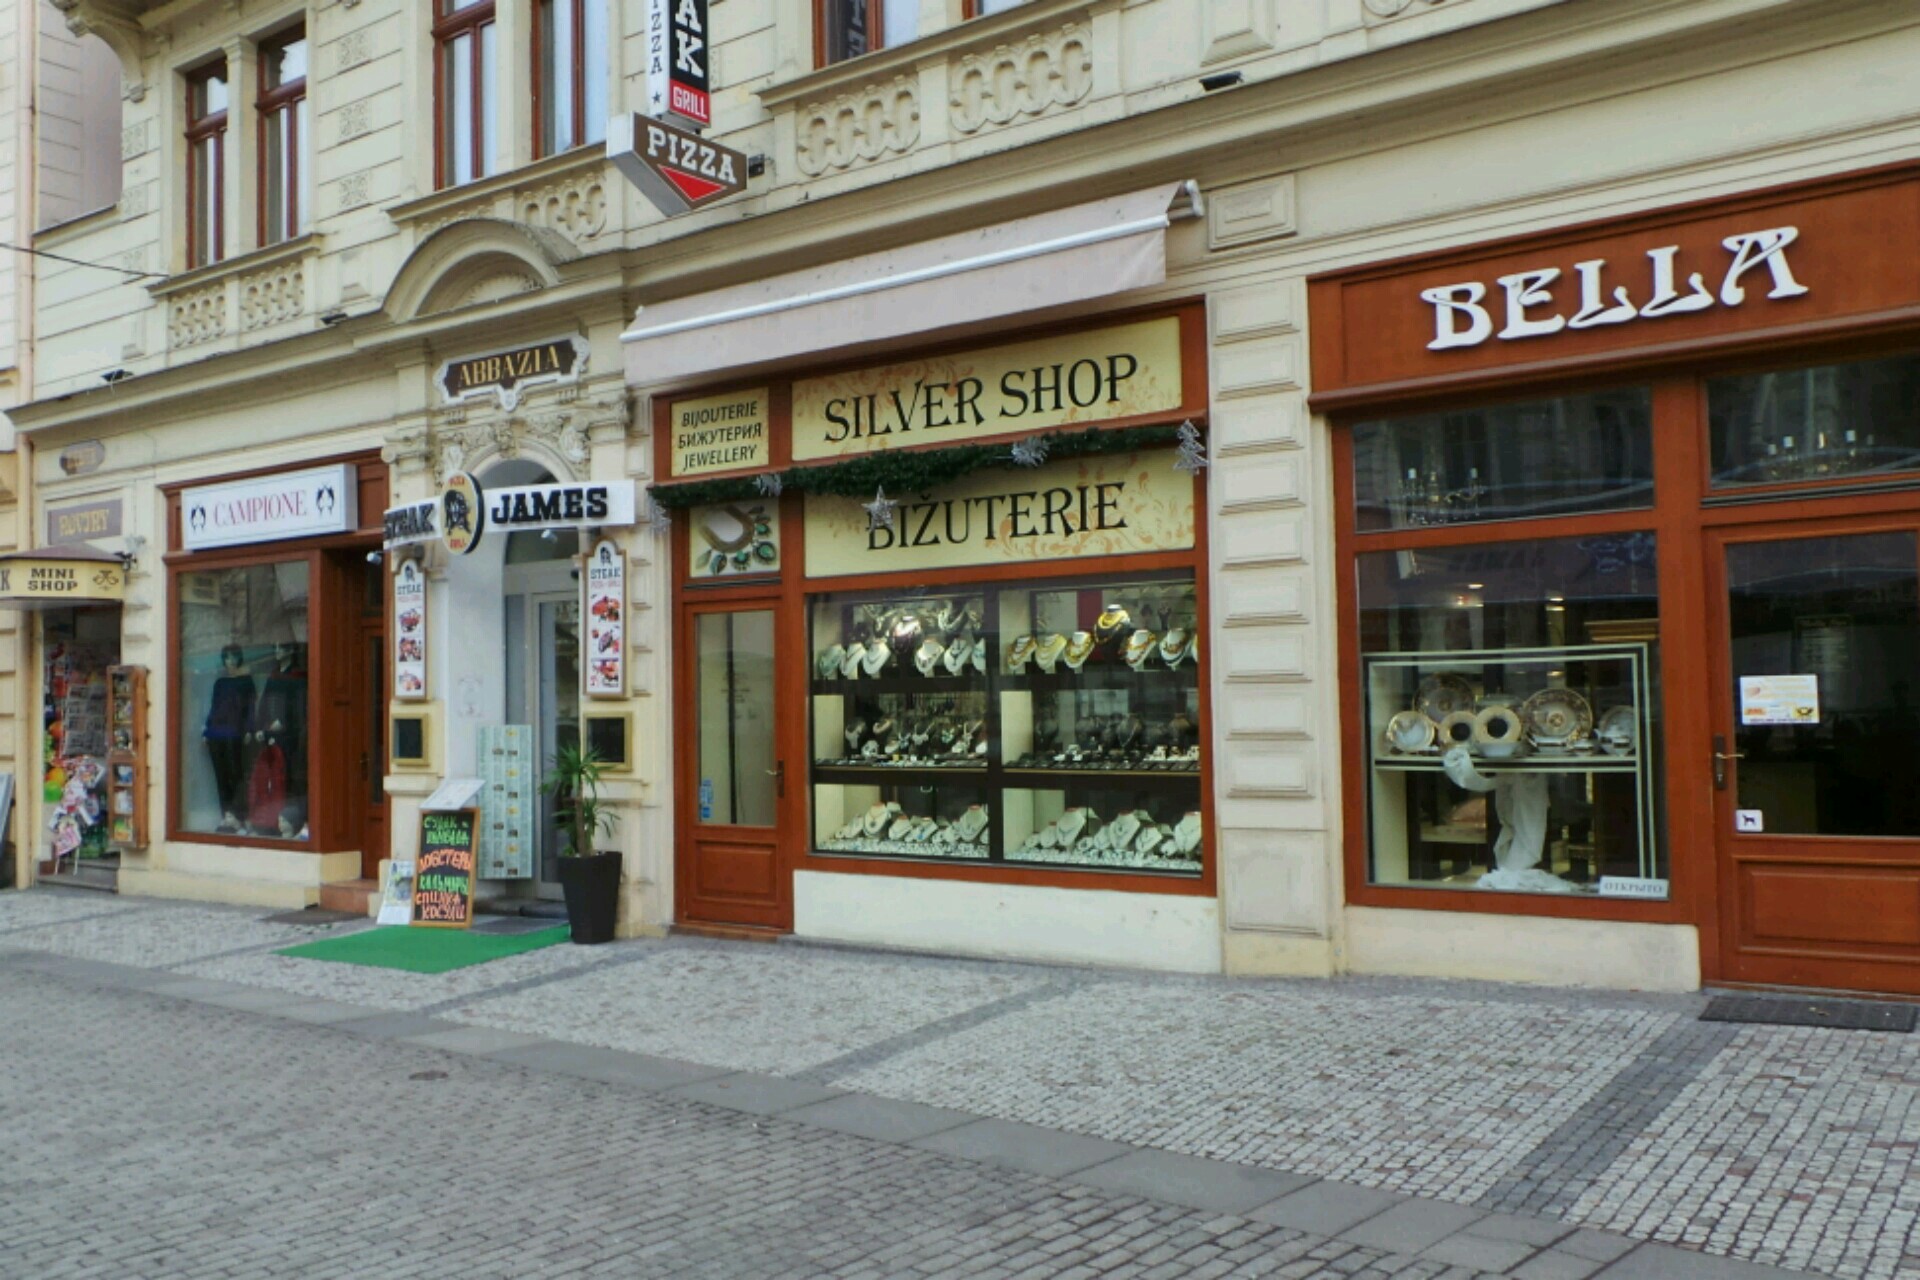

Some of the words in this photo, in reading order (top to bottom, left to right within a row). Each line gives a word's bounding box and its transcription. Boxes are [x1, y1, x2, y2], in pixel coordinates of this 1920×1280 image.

[673, 86, 708, 120] GRILL
[647, 124, 738, 184] PIZZA
[1419, 226, 1810, 351] BELLA
[458, 344, 560, 388] ABBAZIA
[824, 375, 985, 443] SILVER
[1000, 352, 1138, 418] SHOP
[681, 400, 758, 430] BIJOUTERIE
[677, 421, 763, 450] БИЖУТЕРИЯ
[683, 444, 758, 472] JEWELLERY
[213, 489, 308, 527] CAMPIONE
[384, 502, 435, 541] STEAK
[491, 486, 608, 524] JAMES
[27, 580, 78, 591] SHOP
[31, 567, 75, 579] MINI
[1604, 881, 1664, 894] ОТКРЫТО
